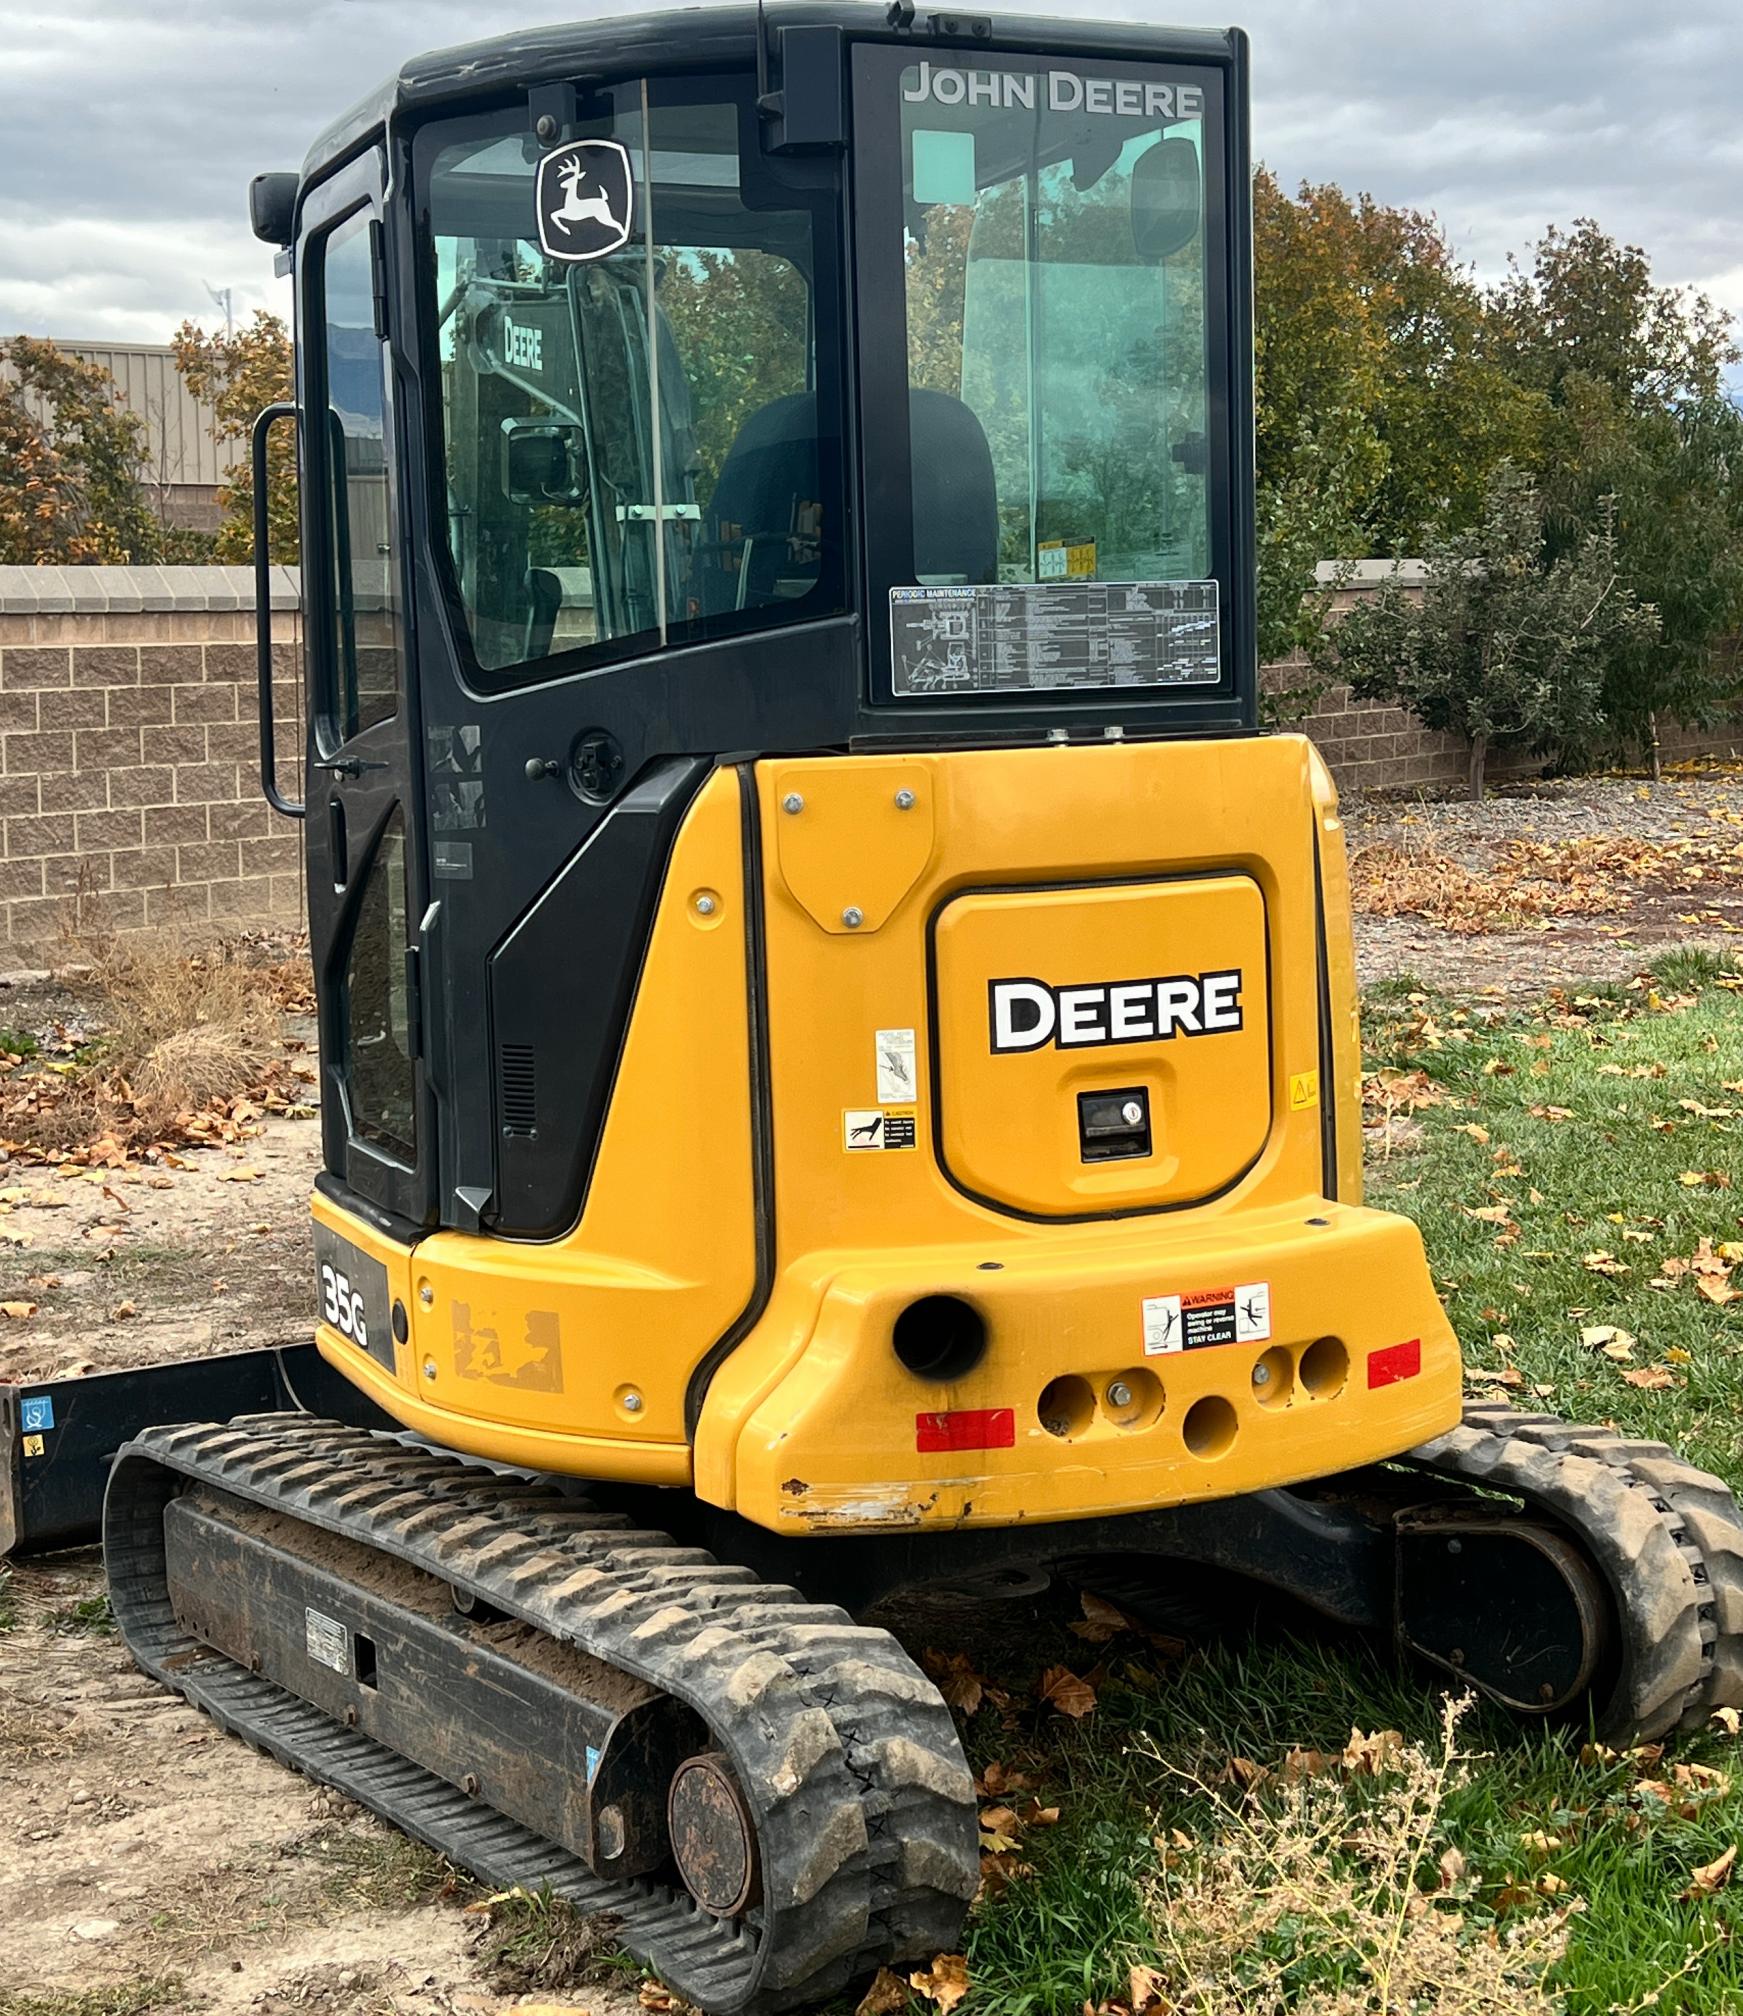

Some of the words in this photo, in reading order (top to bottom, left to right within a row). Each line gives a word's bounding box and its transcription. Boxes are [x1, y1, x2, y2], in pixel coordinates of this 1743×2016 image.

[903, 61, 1034, 110] JOHN
[1048, 70, 1203, 120] DEERE
[503, 315, 543, 371] DEERE
[892, 589, 926, 599] PERIODIC
[926, 588, 977, 598] MAINTENANCE
[992, 972, 1241, 1051] DEERE
[321, 1263, 368, 1347] 35G
[1191, 1290, 1234, 1304] WARNING
[1187, 1335, 1206, 1344] STAY
[1207, 1331, 1231, 1342] CLEAR
